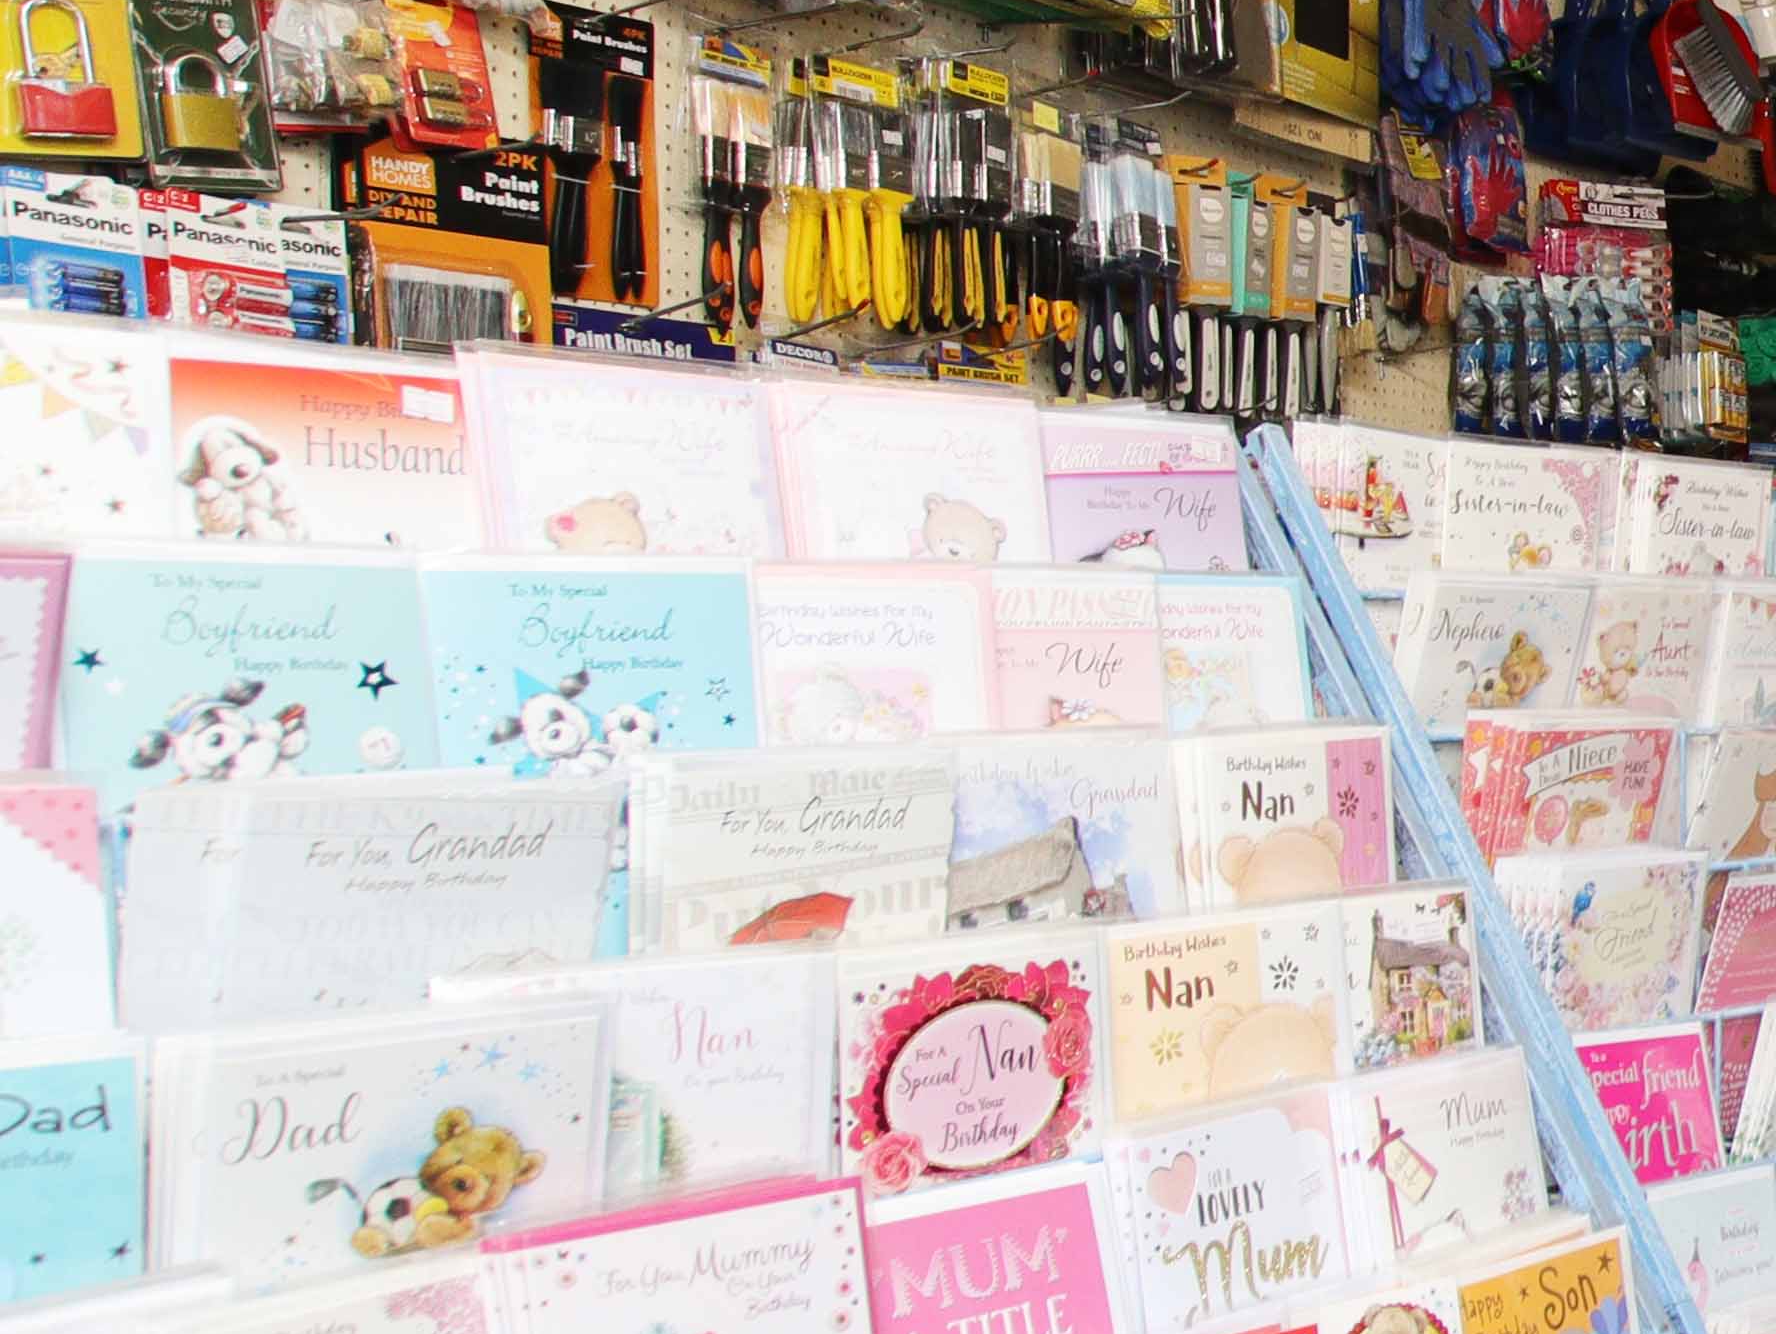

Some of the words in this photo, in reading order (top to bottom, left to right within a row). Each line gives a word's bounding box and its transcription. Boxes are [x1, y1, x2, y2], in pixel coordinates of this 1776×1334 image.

[371, 156, 432, 174] HANDY
[371, 169, 432, 189] HOMES
[496, 151, 538, 171] 2PK
[460, 187, 540, 212] Brushes
[485, 172, 540, 194] Paint
[13, 200, 133, 236] Panasonic
[565, 328, 612, 355] Paint
[614, 334, 661, 357] Brush
[663, 338, 694, 361] Set
[302, 426, 468, 477] Husband
[1155, 487, 1218, 525] Wife
[1450, 490, 1569, 520] Sister-in-law
[1657, 510, 1755, 542] Sister-in-law
[159, 596, 339, 646] Boyfriend
[517, 599, 676, 650] Boyfriend
[759, 622, 877, 649] Wonderful
[886, 618, 937, 651] Wife
[1428, 611, 1505, 652] Nephew
[1045, 640, 1125, 689] Wife
[1568, 744, 1619, 773] Niece
[1240, 779, 1296, 823] Nan
[1144, 969, 1216, 1013] Nan
[896, 1065, 960, 1098] Special
[962, 1023, 1039, 1097] Nan
[222, 1092, 363, 1167] Dad
[1439, 1095, 1508, 1133] Mum
[939, 1119, 1020, 1155] Birthday
[1198, 1179, 1267, 1228] LOVELY
[1162, 1219, 1331, 1329] Mum
